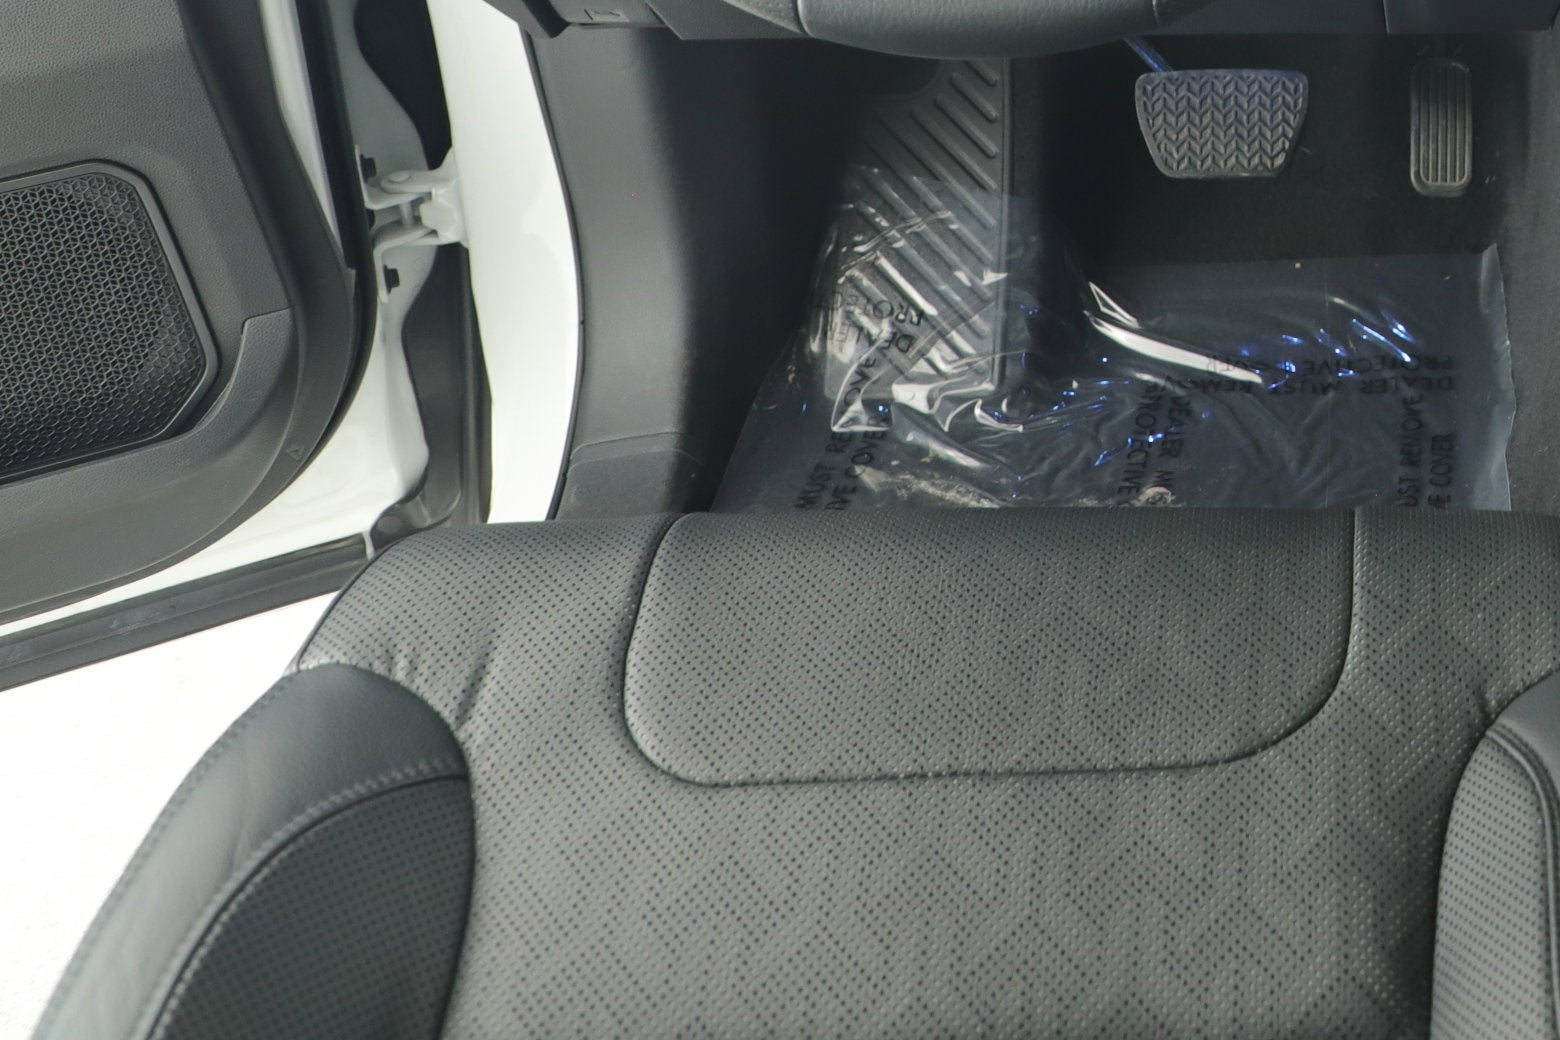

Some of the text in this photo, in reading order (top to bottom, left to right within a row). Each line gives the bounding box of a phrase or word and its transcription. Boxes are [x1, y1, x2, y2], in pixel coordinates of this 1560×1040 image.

[1360, 375, 1453, 395] DEALER
[1400, 393, 1424, 468] REMOVE
[1430, 433, 1454, 487] COVER
[795, 463, 837, 510] MUST
